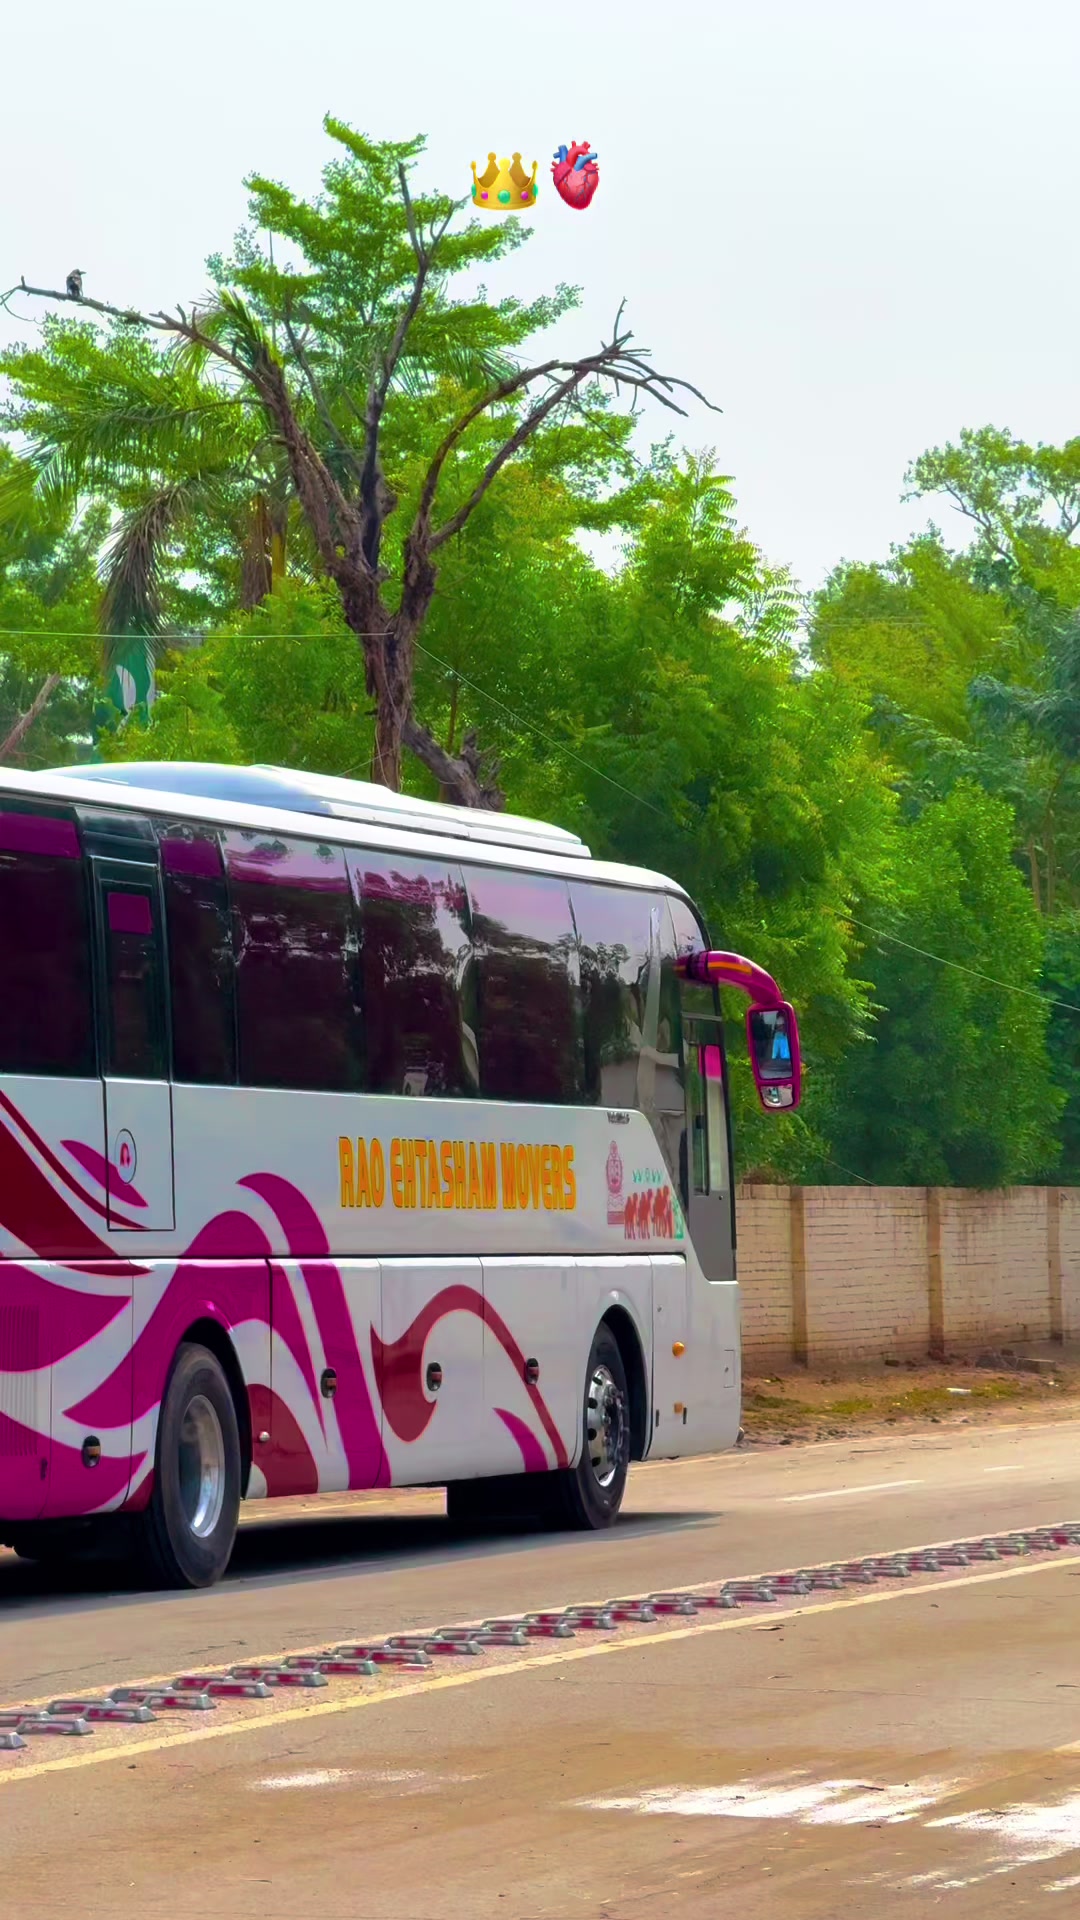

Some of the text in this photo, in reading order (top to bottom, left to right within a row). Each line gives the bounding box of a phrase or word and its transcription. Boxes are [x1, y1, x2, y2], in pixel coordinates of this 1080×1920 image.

[338, 1136, 577, 1211] RAO EHTASHAM MOVERS
